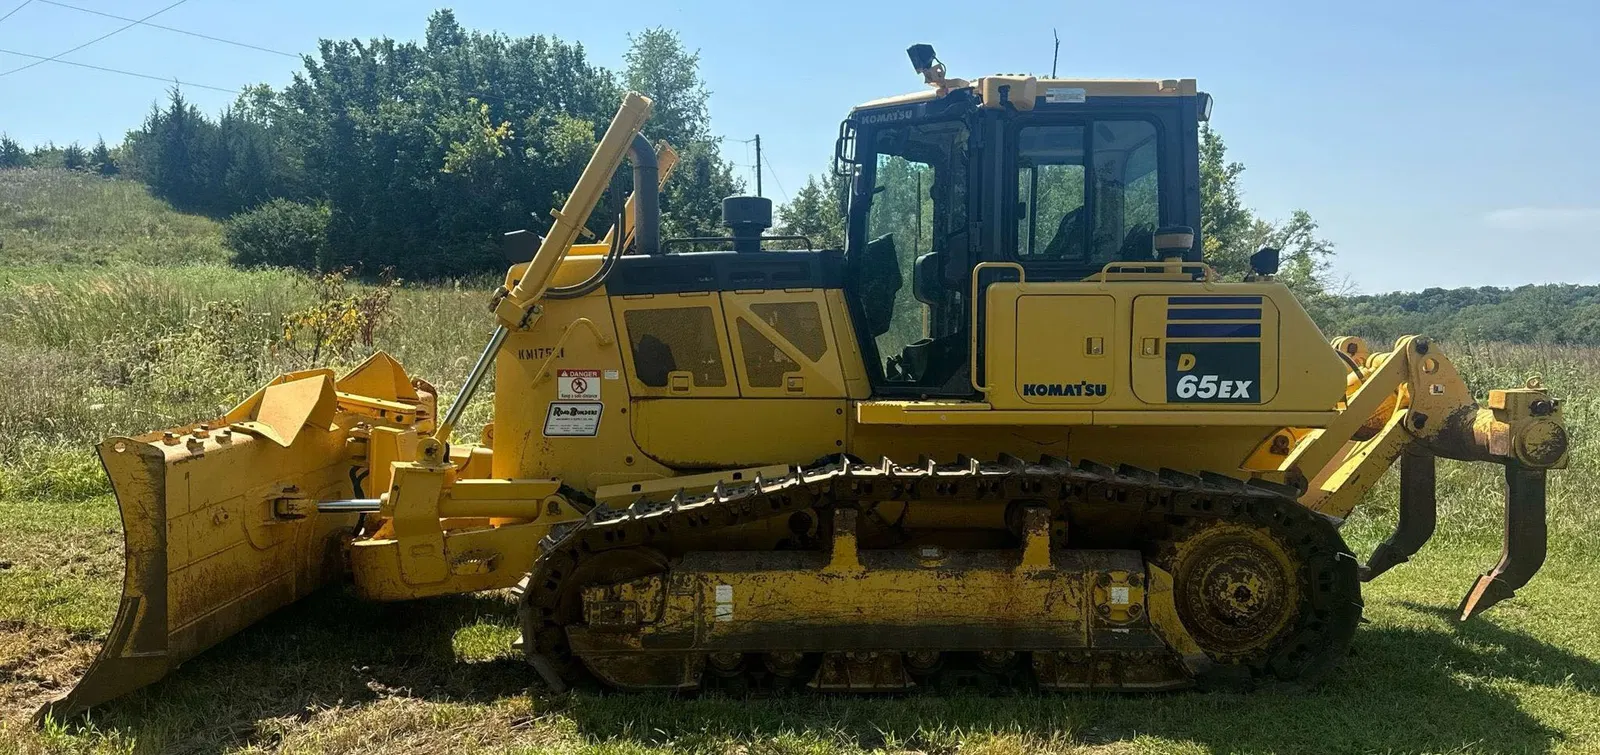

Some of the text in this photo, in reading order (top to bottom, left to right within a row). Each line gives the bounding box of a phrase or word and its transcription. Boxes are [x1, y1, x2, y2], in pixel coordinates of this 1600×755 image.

[861, 109, 913, 125] KOMATSU
[1177, 353, 1196, 371] D
[1023, 380, 1107, 397] KOMATSU
[1176, 374, 1253, 399] 65EX
